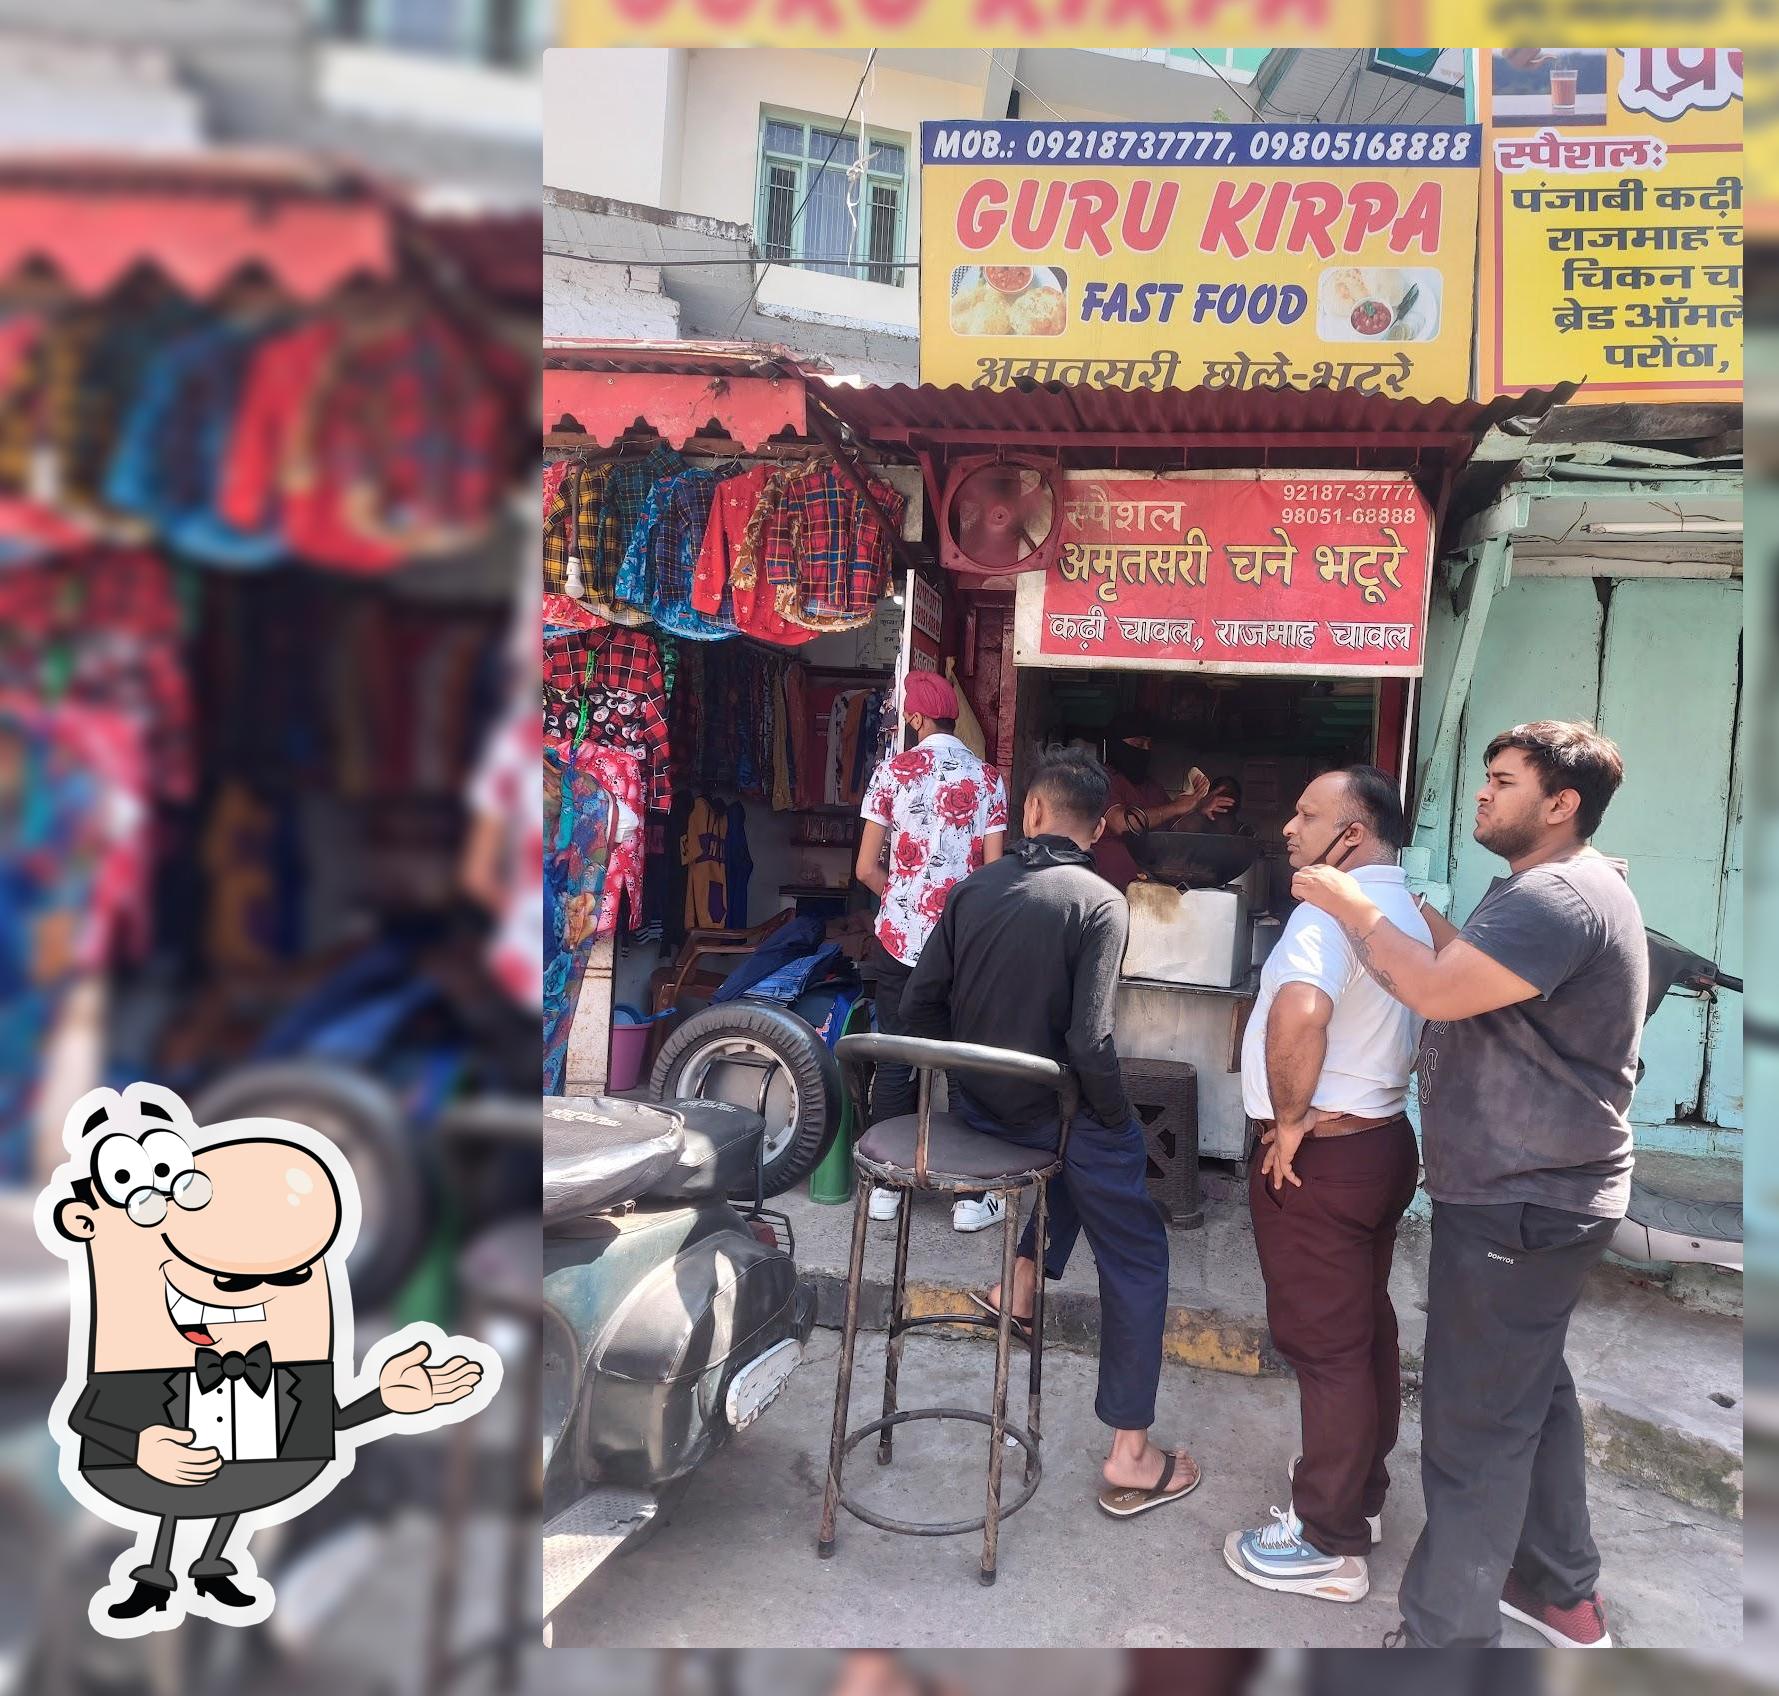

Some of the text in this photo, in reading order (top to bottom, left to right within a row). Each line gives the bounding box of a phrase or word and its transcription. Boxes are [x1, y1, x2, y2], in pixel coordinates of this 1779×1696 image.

[933, 130, 1471, 164] MOB.: 09218737777, 09805168888
[1511, 176, 1743, 219] पंजाबी कढ़ी
[956, 178, 1442, 260] GURU KIRPA
[1546, 226, 1714, 251] राजमाह
[1562, 257, 1695, 291] चिकन
[1080, 282, 1308, 325] FAST FOOD
[1552, 298, 1617, 334] ब्रेड
[1603, 335, 1729, 373] परोंठा,
[1064, 484, 1188, 532] स्पैशल
[1283, 484, 1417, 501] 92187-37777
[1281, 507, 1416, 525] 98051-68888
[1059, 527, 1409, 603] अमृतसरी चने भटूरे
[1046, 604, 1415, 653] कढ़ी चावल, राजमाह चावल
